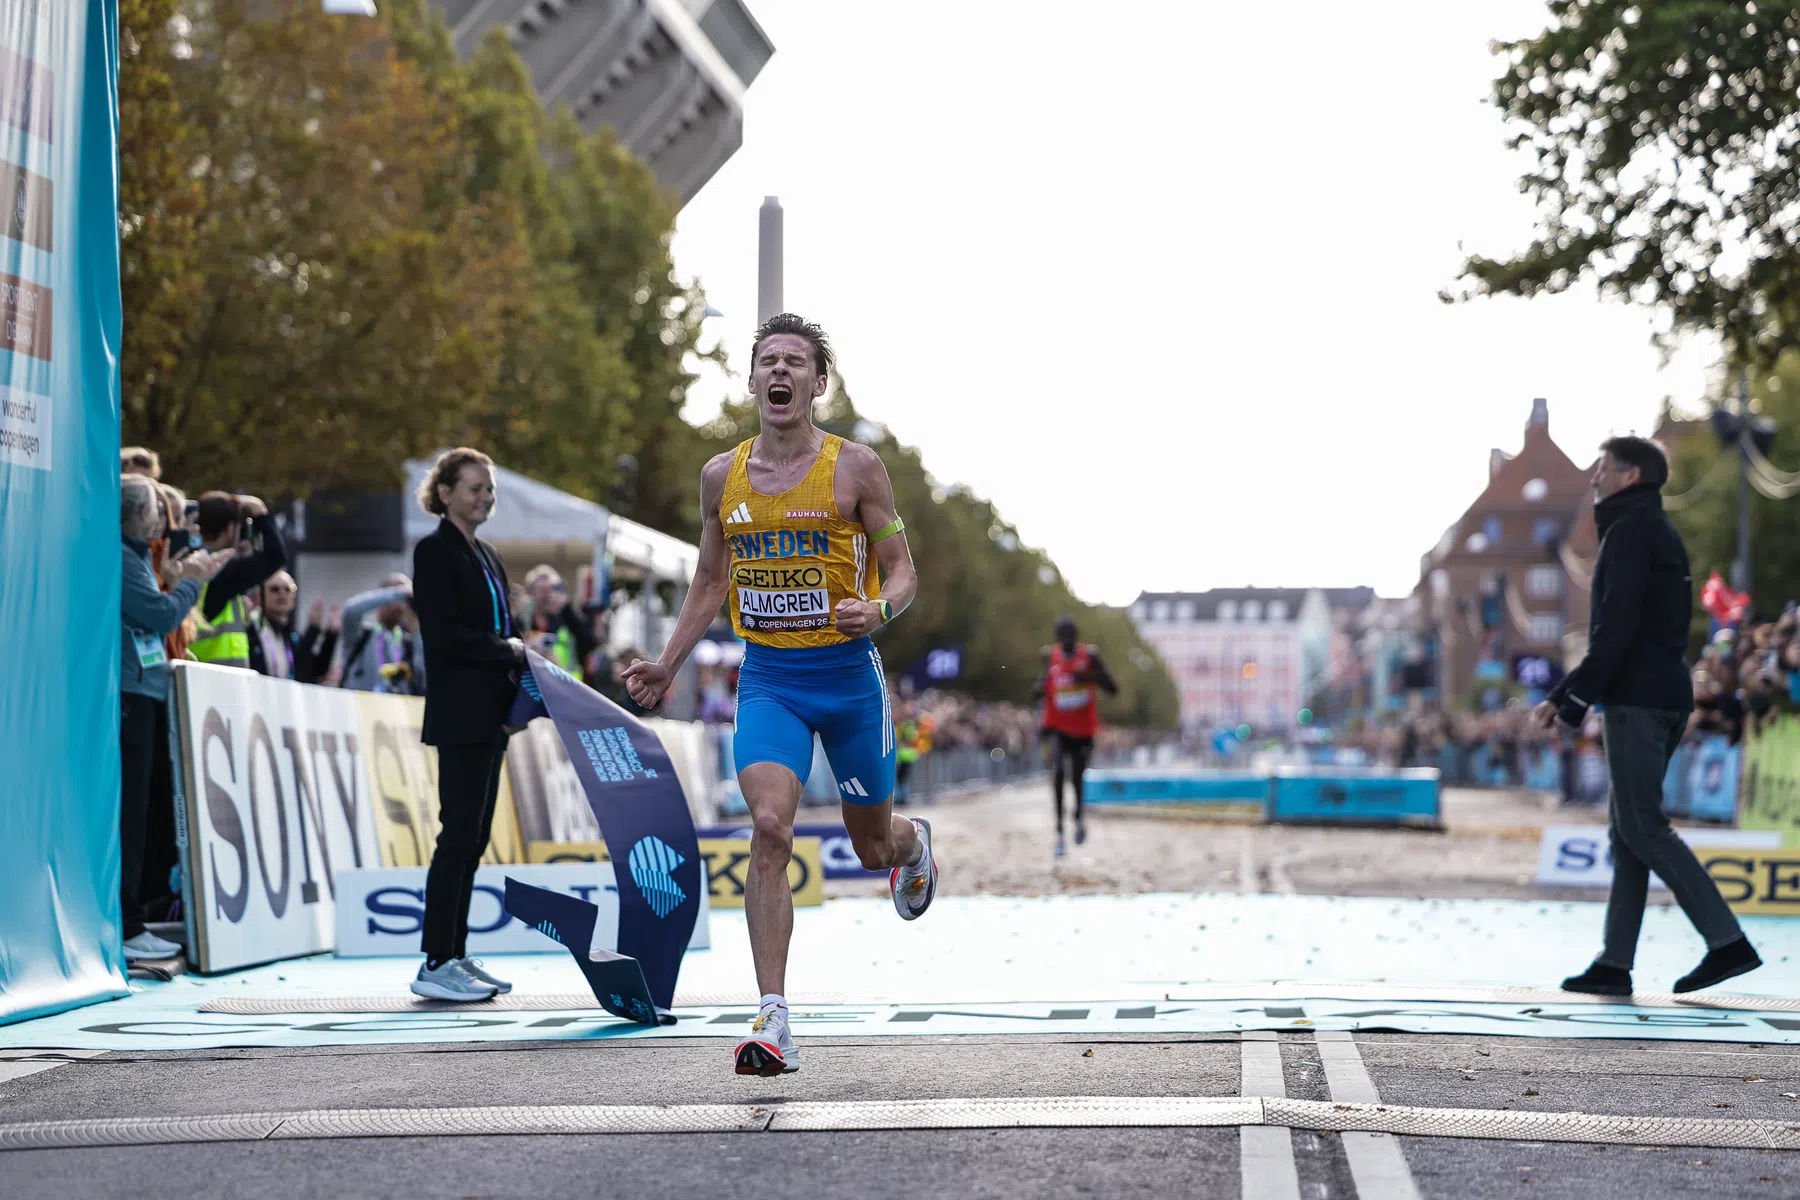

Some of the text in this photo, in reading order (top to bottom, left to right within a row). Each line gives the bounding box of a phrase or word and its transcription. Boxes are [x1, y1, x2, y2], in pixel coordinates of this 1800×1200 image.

[731, 530, 830, 559] SWEDEN
[736, 567, 823, 588] SEIKO
[742, 590, 824, 614] ALMGREN
[758, 618, 828, 628] COPENHAGEN 26
[589, 729, 622, 782] ROAD RUNNING
[614, 727, 644, 772] COPENHAGEN
[202, 706, 362, 924] SONY
